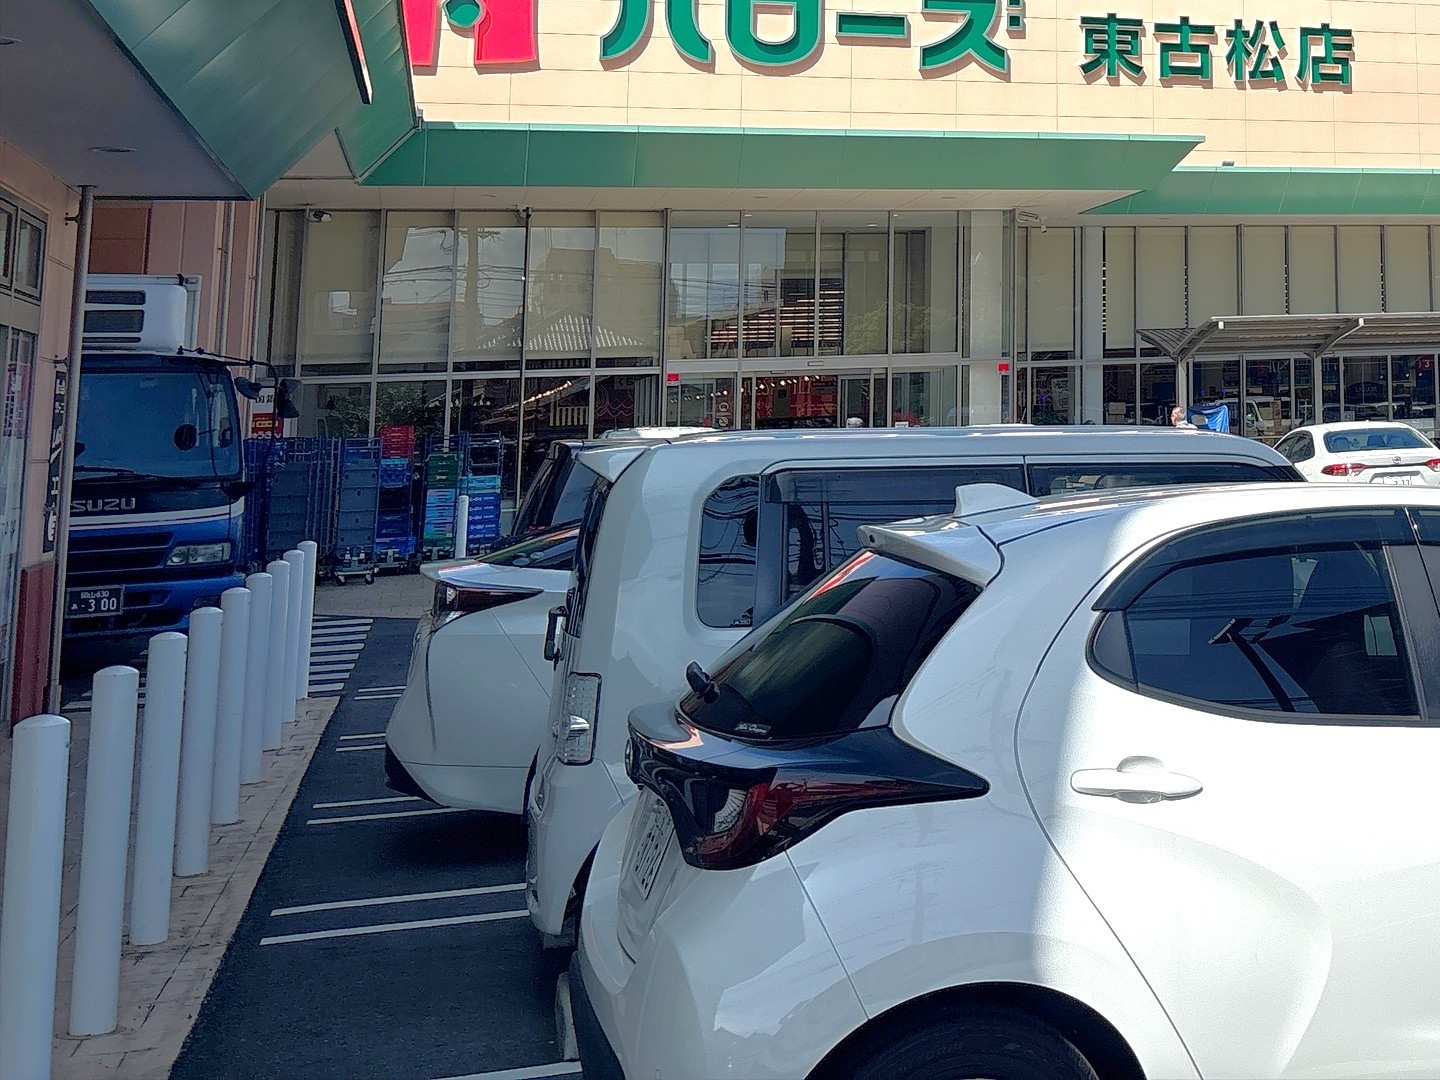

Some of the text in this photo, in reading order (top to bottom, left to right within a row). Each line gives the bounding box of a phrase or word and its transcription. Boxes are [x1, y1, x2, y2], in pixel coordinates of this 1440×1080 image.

[1080, 12, 1354, 91] 東古松店
[70, 498, 135, 512] SUZU
